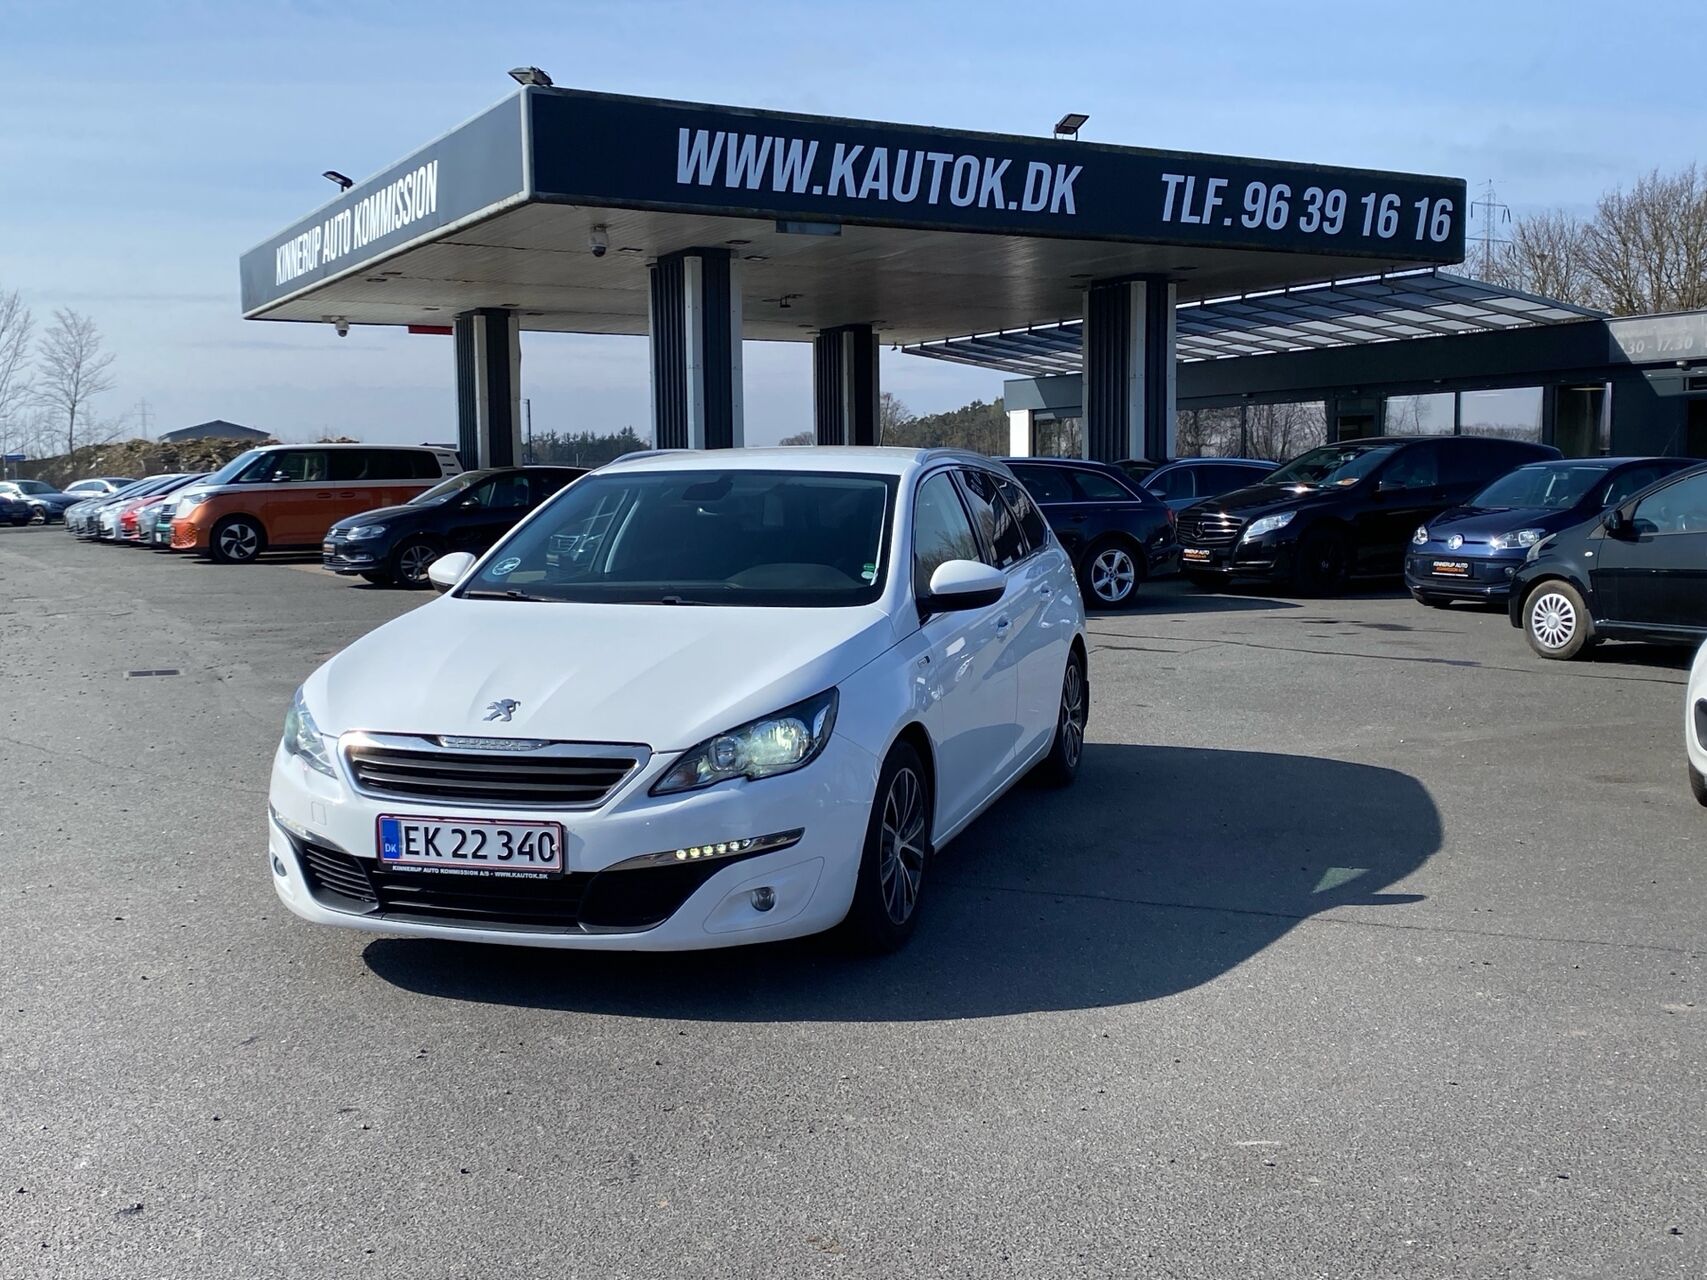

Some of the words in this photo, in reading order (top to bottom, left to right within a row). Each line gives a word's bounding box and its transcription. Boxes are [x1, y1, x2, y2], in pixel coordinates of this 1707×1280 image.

[677, 127, 1084, 215] WWW.KAUTOK.DK
[276, 225, 322, 286] KINNERUP
[322, 208, 351, 264] AUTO
[353, 159, 438, 250] KOMMISSION
[1161, 173, 1232, 226] TLF.
[1241, 181, 1291, 230] 96
[1299, 186, 1347, 235] 39
[1361, 192, 1401, 238] 16
[1414, 197, 1453, 242] 16
[385, 843, 397, 853] DK
[404, 826, 442, 857] EK
[451, 828, 488, 860] 22
[497, 830, 556, 863] 340
[440, 868, 479, 876] KOMMISSION
[494, 871, 548, 879] WWW.KAUTOK.DK
